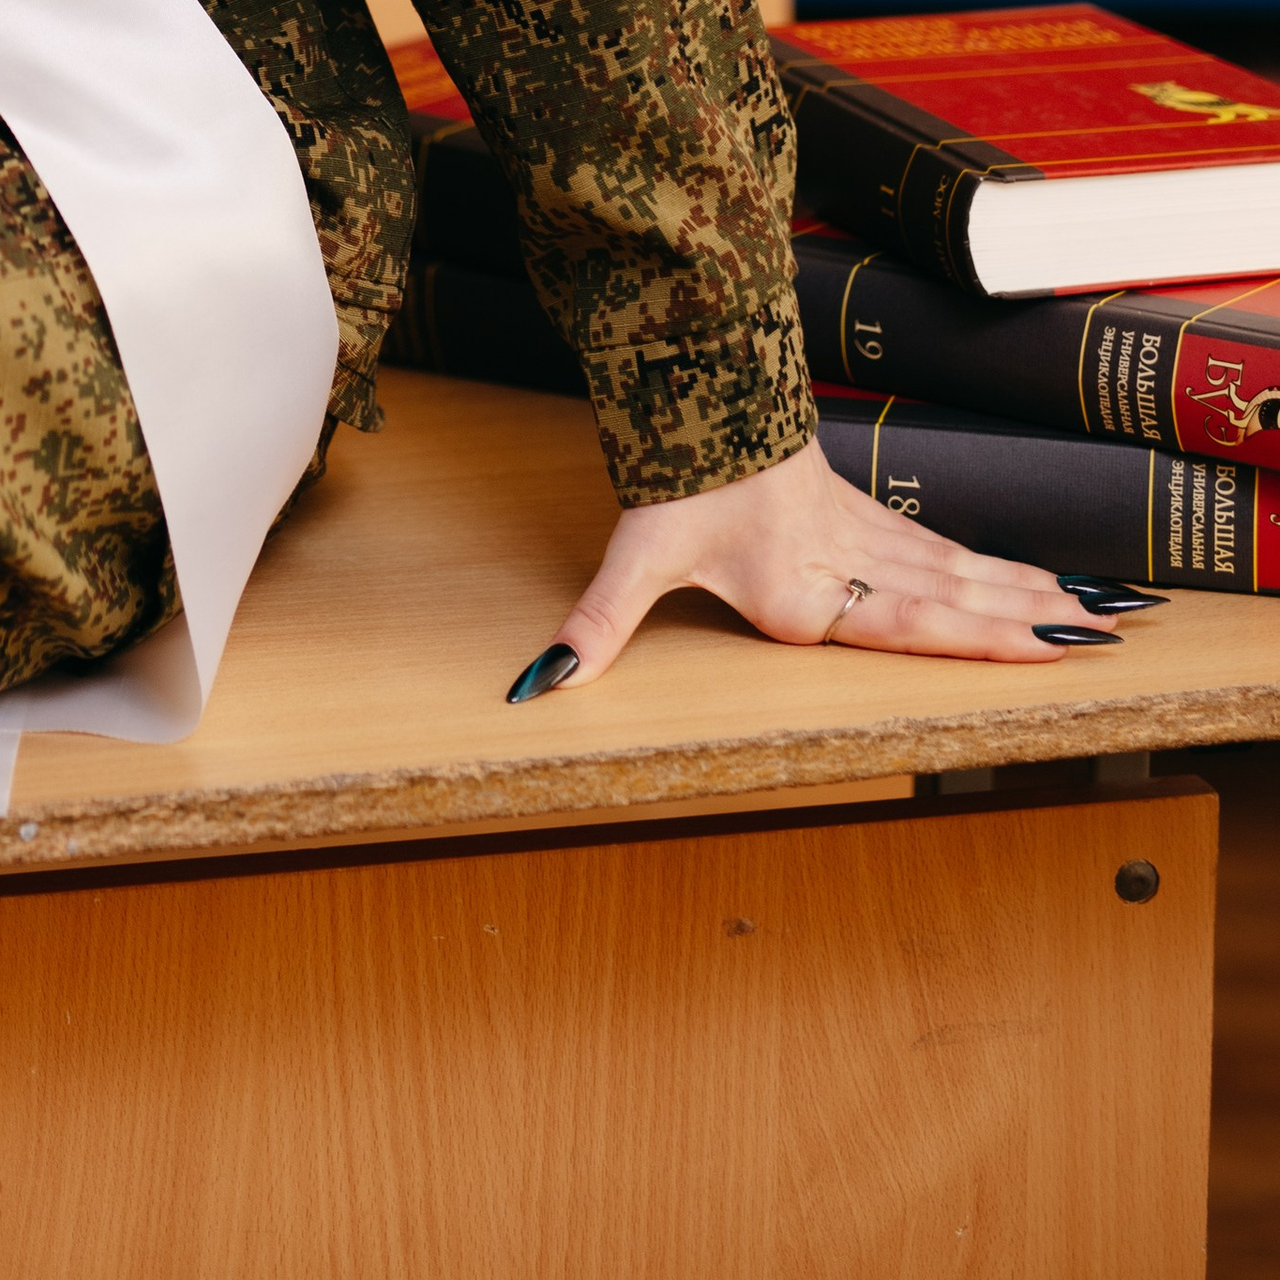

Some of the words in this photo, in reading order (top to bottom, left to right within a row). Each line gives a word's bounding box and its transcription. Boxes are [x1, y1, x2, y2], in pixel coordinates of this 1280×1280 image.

[854, 319, 883, 360] 19
[1097, 325, 1117, 432] ЭНЦИКЛОПЕДИЯ
[1116, 330, 1136, 435] УНИВЕРСАЛЬНАЯ
[1135, 332, 1162, 441] БОЛЬШАЯ
[1185, 353, 1248, 447] БУЭ
[887, 475, 920, 516] 18
[1167, 459, 1185, 569] ЭНЦИКЛОПЕДИЯ
[1191, 463, 1207, 570] УНИВЕРСАЛЬНАЯ
[1214, 464, 1236, 574] БОЛЬШАЯ
